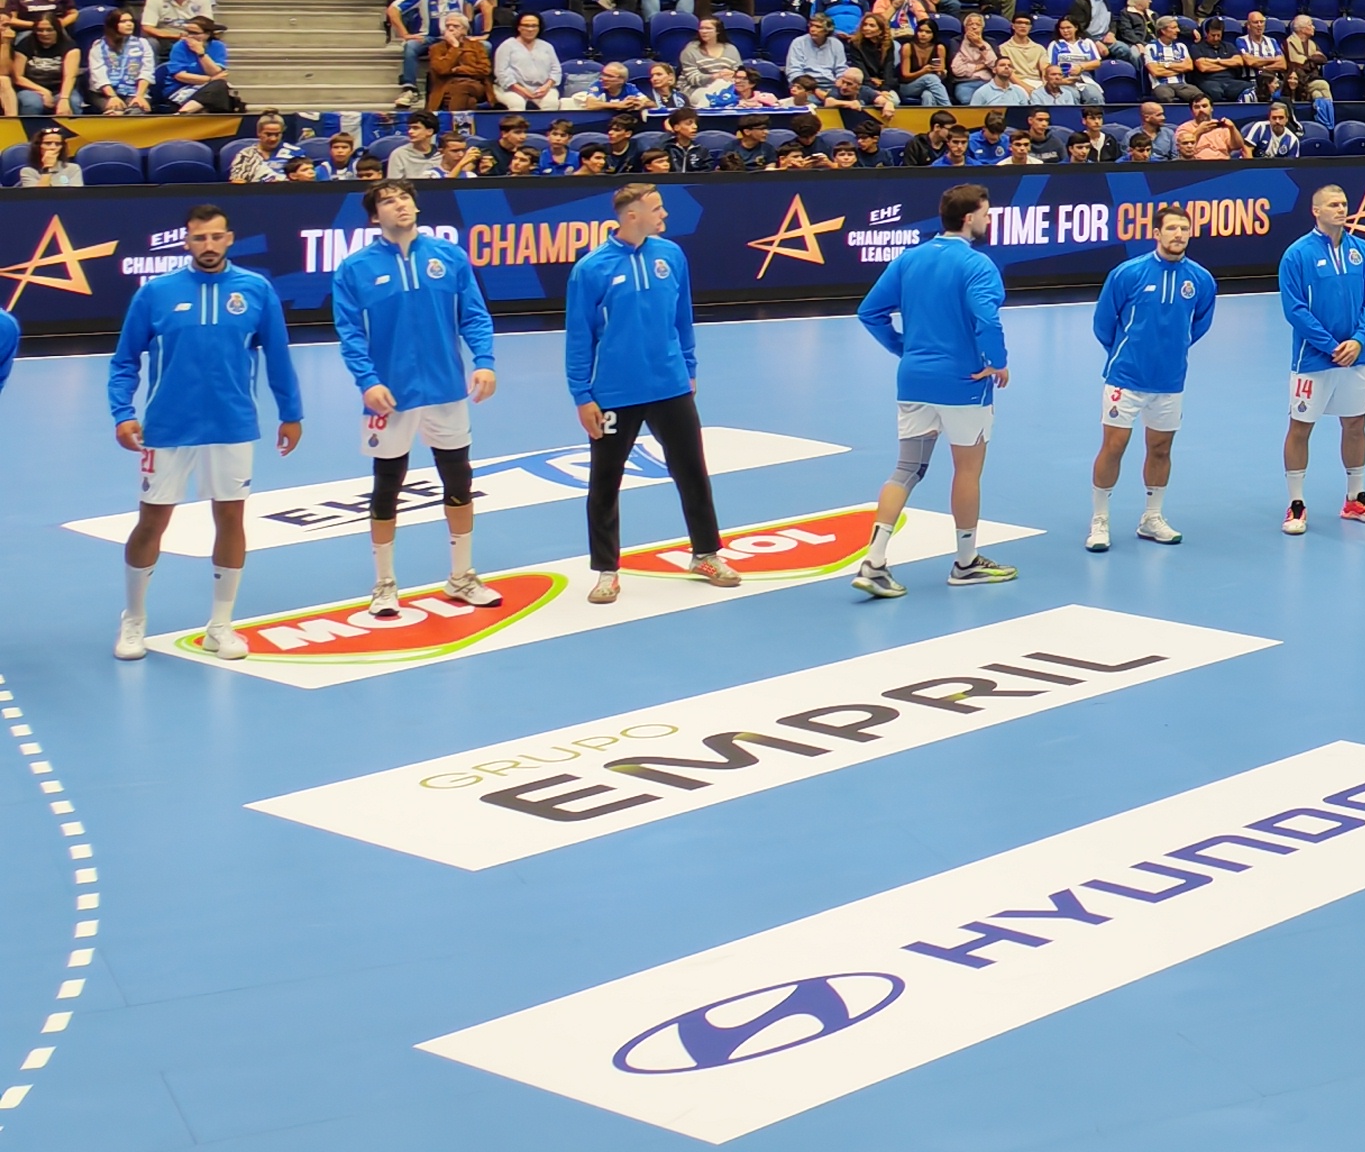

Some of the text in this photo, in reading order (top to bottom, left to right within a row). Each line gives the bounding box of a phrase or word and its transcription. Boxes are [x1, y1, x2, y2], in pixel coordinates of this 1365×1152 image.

[869, 204, 902, 221] EHF
[988, 198, 1270, 246] TIME FOR CHPIONS
[847, 230, 920, 247] CHAMPIONS
[122, 255, 195, 275] CHAMPIO
[860, 246, 901, 263] LEAGU
[1294, 378, 1313, 400] 14
[261, 594, 476, 652] MOL
[478, 651, 1170, 823] EMPRIL
[418, 723, 679, 791] GRUPO
